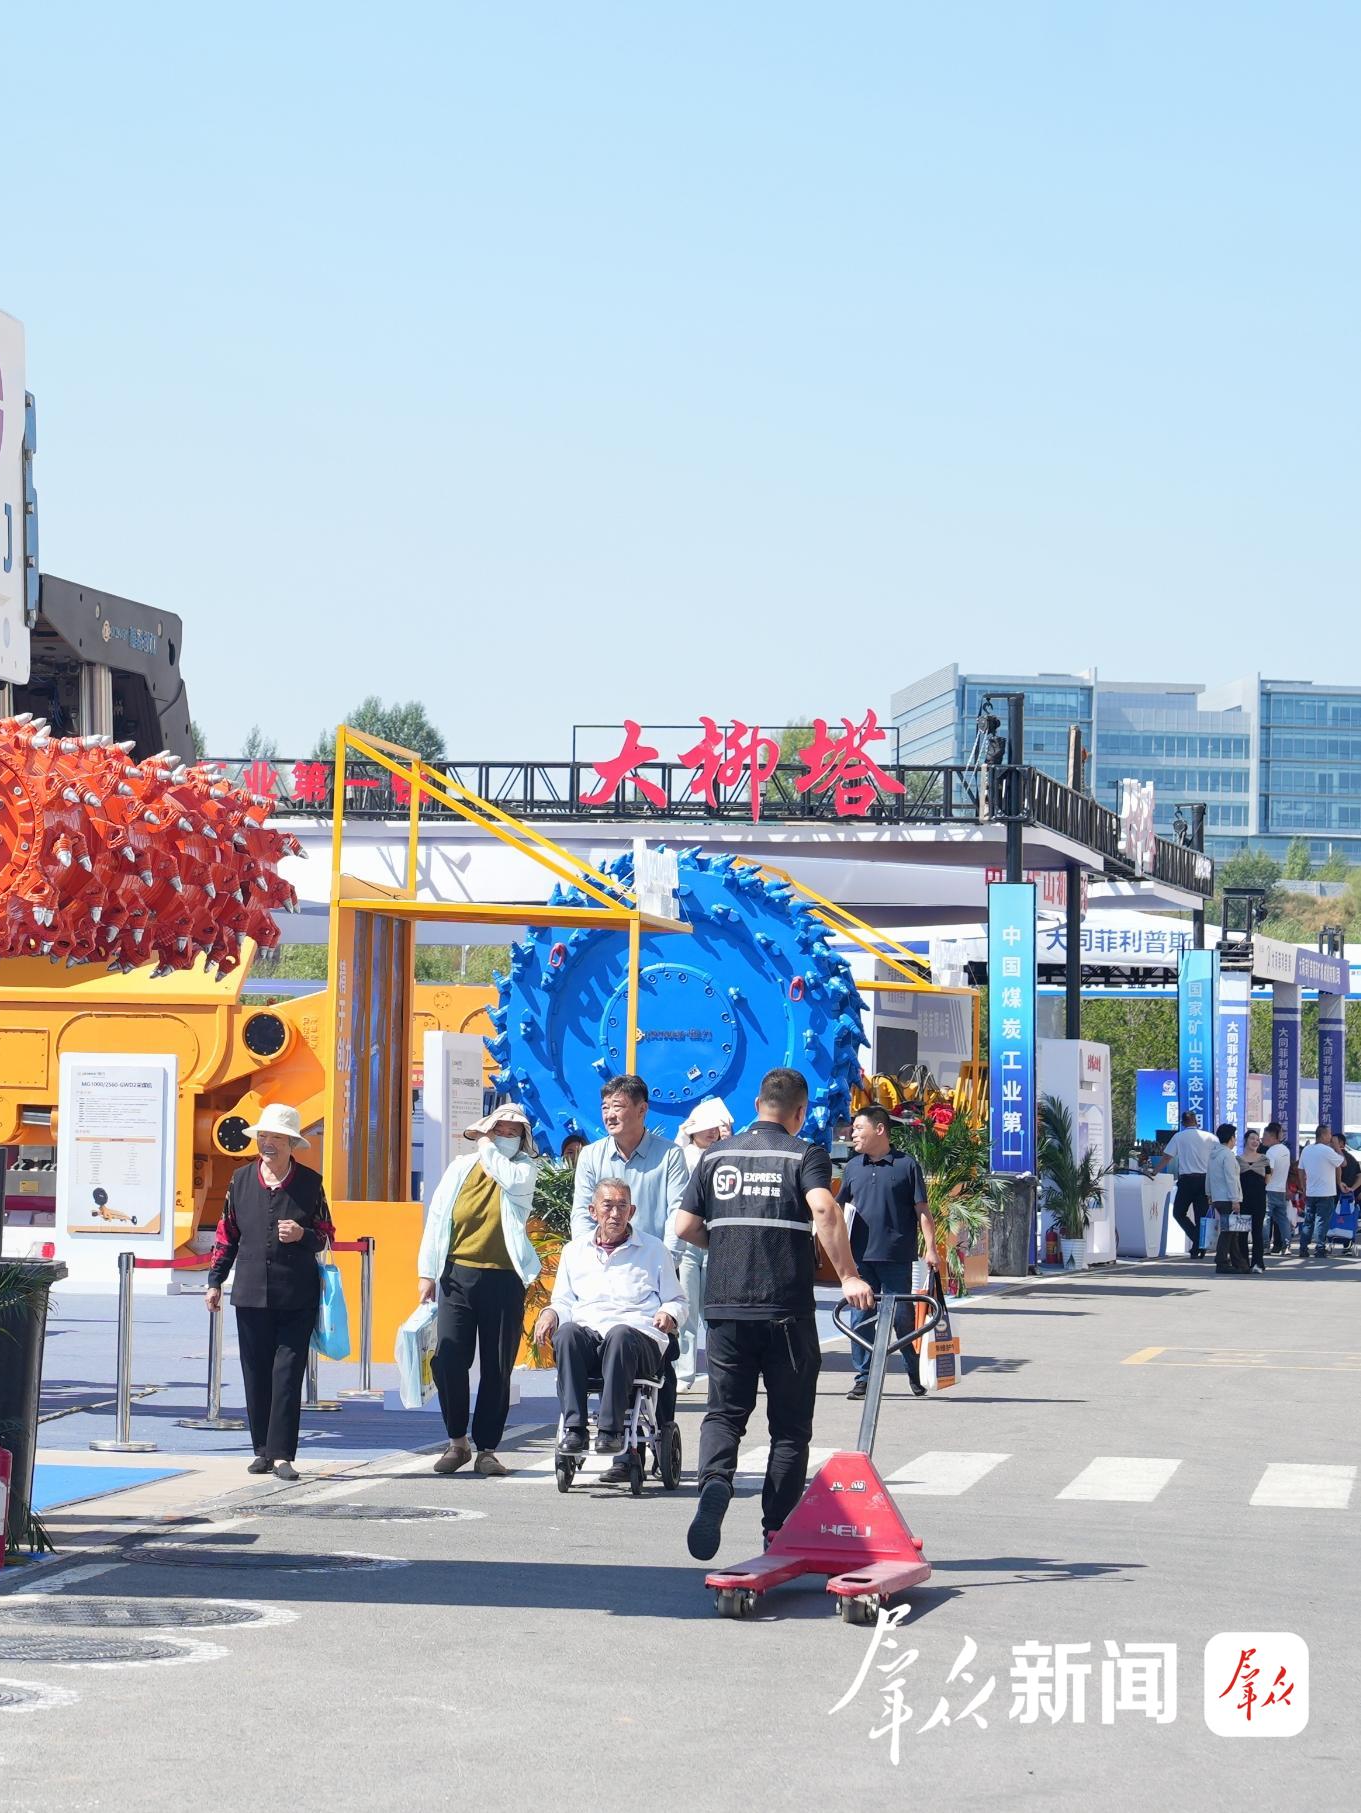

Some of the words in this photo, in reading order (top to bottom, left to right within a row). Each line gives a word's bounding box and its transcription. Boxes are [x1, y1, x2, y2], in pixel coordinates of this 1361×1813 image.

[579, 708, 906, 825] 大柳塔
[1046, 928, 1195, 954] 大同菲利普斯
[1001, 925, 1023, 1156] 中国煤炭工业第一
[1226, 1020, 1239, 1130] 大同菲利普斯采矿机
[743, 1172, 783, 1184] EXPRESS
